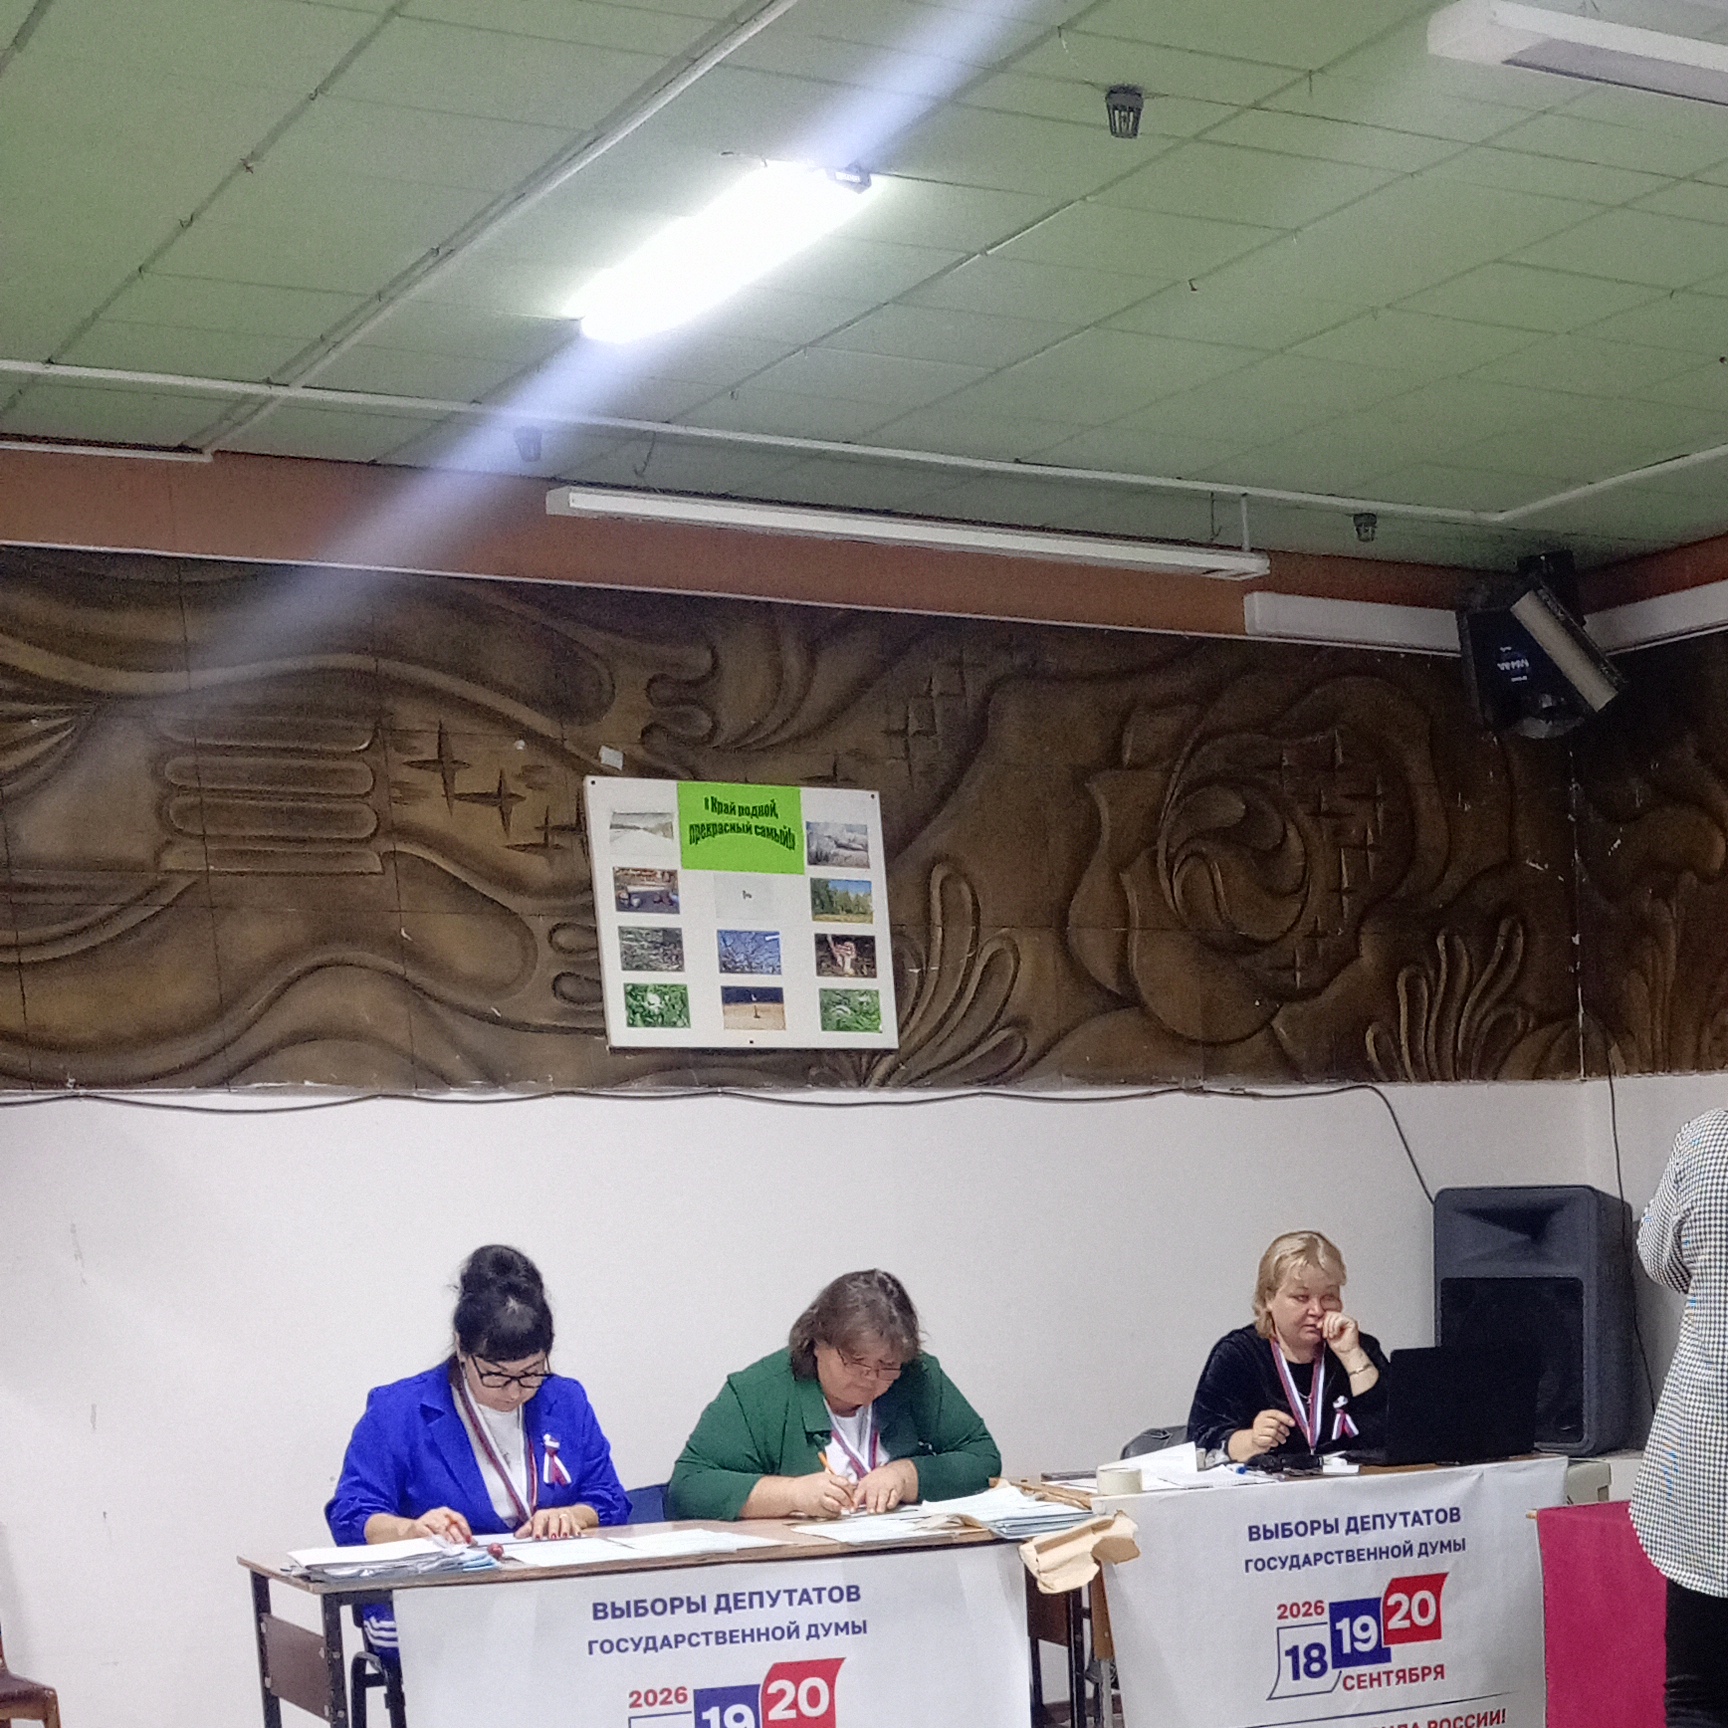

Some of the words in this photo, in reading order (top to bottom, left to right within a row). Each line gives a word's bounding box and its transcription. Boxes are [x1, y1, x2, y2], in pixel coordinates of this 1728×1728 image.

[689, 821, 752, 845] прекрасный
[1247, 1518, 1339, 1542] ВЫБОРЫ
[1345, 1507, 1461, 1536] ДЕПУТАТОВ
[1244, 1540, 1413, 1573] ГОСУДАРСТВЕННОЙ
[1417, 1538, 1466, 1558] ДУМЫ
[592, 1594, 707, 1620] ВЫБОРЫ
[714, 1585, 861, 1614] ДЕПУТАТОВ
[1276, 1600, 1325, 1620] 2026
[587, 1621, 800, 1655] ГОСУДАРСТВЕННОЙ
[805, 1620, 868, 1641] ДУМЫ
[1285, 1642, 1328, 1681] 18
[1335, 1615, 1379, 1654] 19
[1387, 1590, 1437, 1630] 20
[1343, 1664, 1445, 1691] СЕНТЯБРЯ
[629, 1686, 688, 1709] 2026
[767, 1676, 830, 1721] 20
